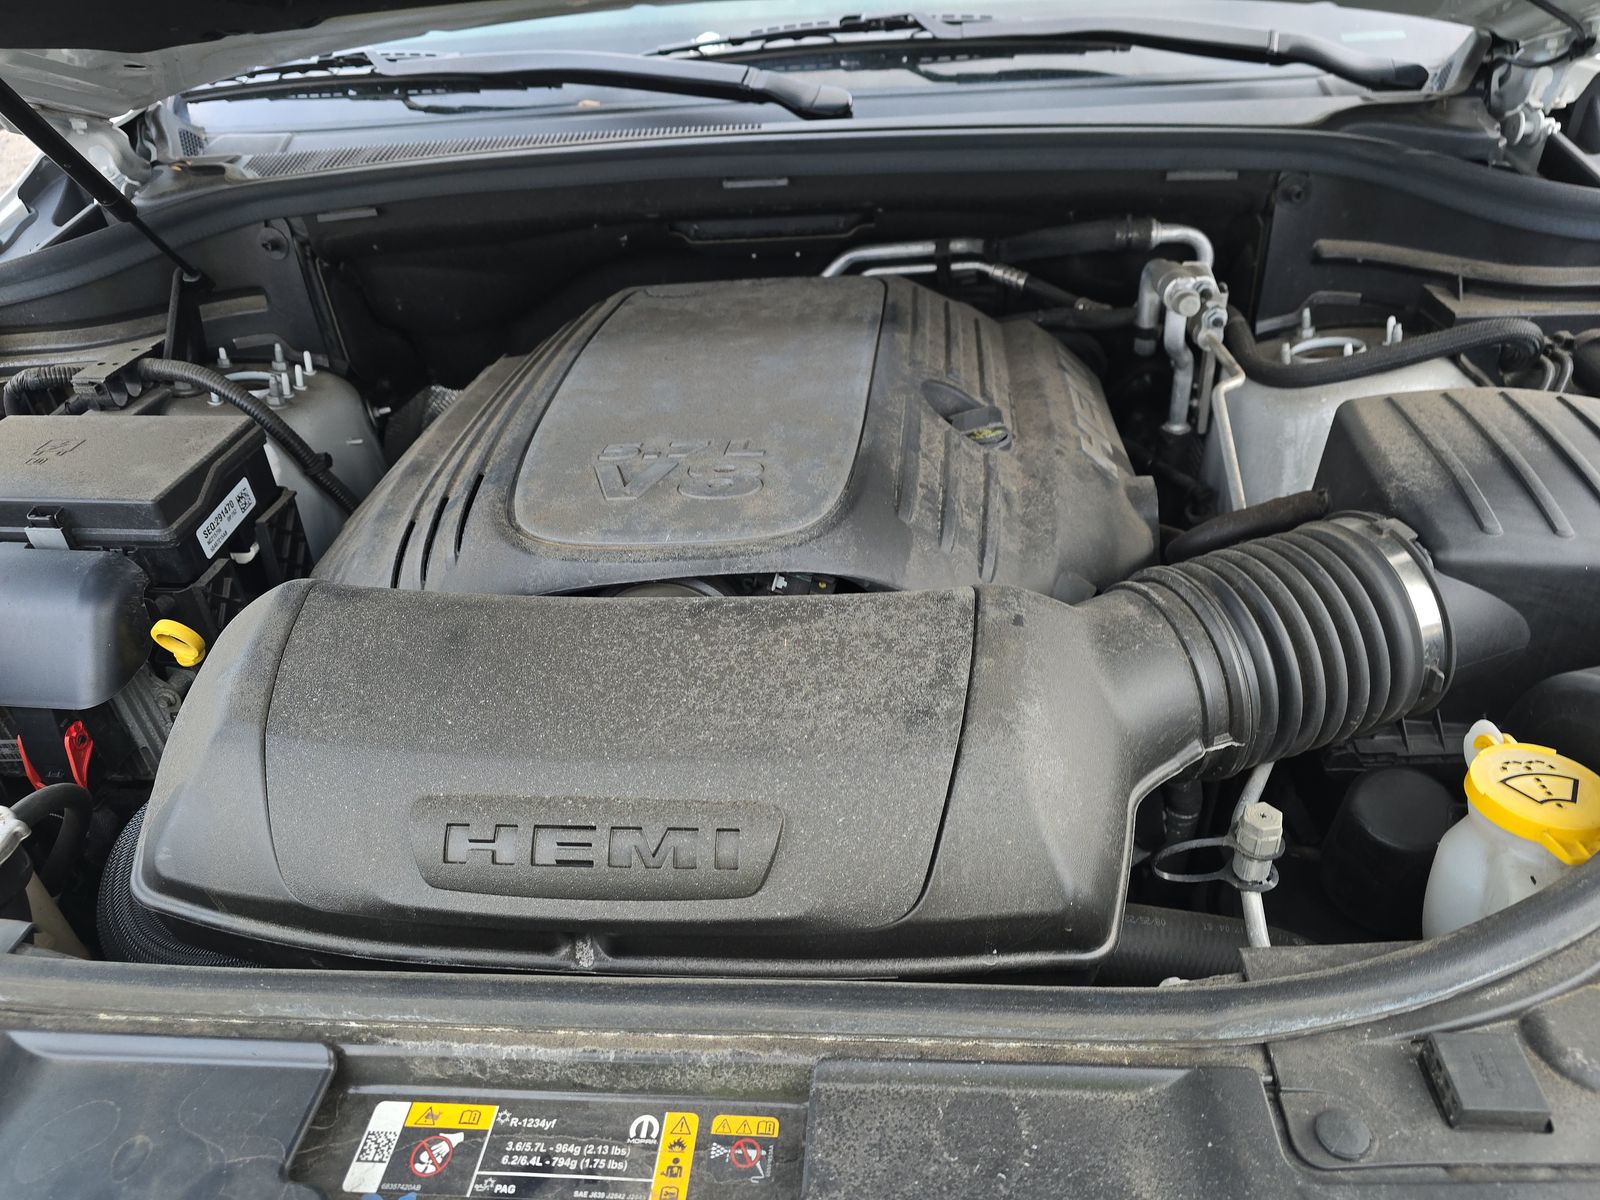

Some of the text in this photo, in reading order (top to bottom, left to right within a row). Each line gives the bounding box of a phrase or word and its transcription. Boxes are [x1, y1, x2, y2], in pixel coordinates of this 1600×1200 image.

[593, 461, 766, 501] V8
[202, 499, 235, 539] SEQ:291470
[442, 822, 741, 871] HEMI
[509, 1117, 557, 1130] R-1234yf
[506, 1141, 547, 1153] 3.6/5.7L
[555, 1143, 581, 1156] 964g
[583, 1144, 608, 1156] (2.13
[610, 1145, 631, 1157] lbs)
[501, 1155, 543, 1167] 6.2/6.4L
[552, 1157, 578, 1169] 794g
[580, 1157, 606, 1170] (1.75
[607, 1158, 628, 1171] lbs)
[494, 1184, 516, 1194] PAG
[573, 1190, 589, 1198] SAE
